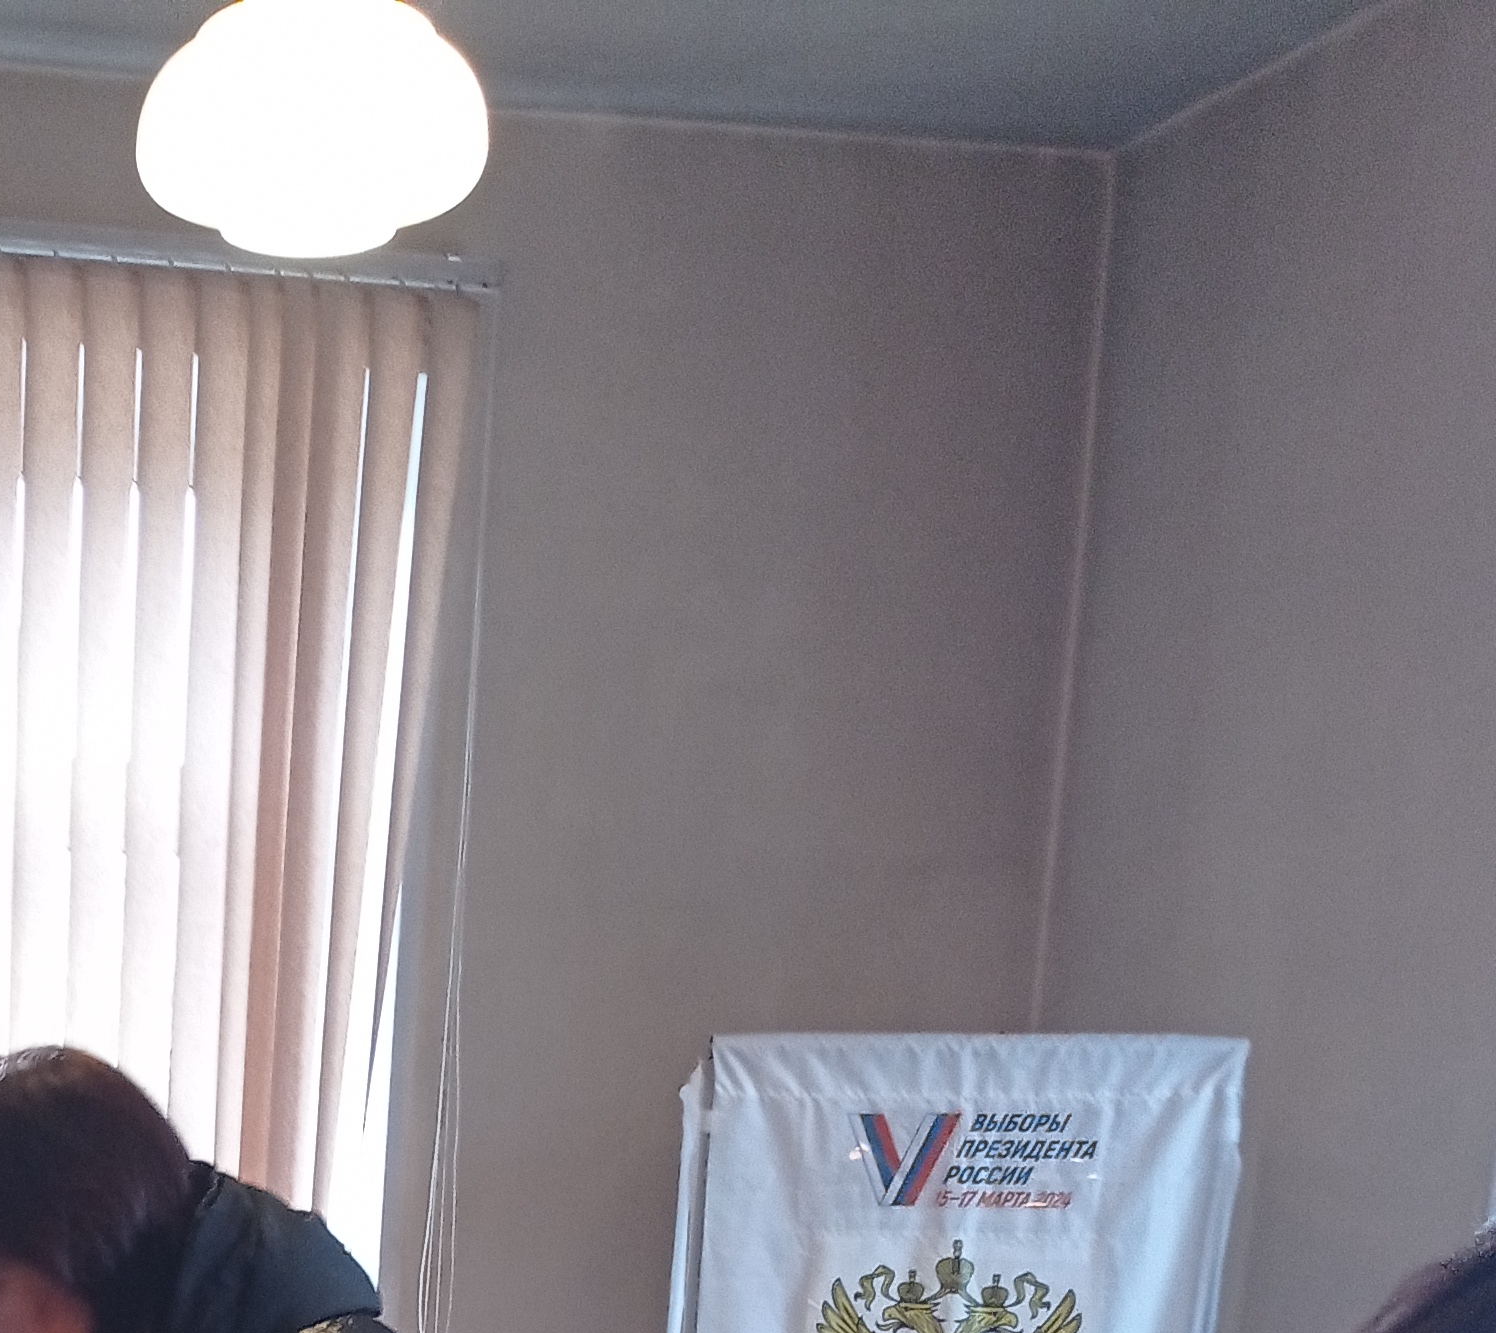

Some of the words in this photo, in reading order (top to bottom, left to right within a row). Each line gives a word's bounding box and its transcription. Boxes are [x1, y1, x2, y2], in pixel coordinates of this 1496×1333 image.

[969, 1112, 1072, 1133] ВЫБОРЫ
[956, 1139, 1099, 1162] ПРЕЗИДЕНТА
[943, 1165, 1035, 1185] РОССИИ
[975, 1190, 1032, 1208] МАРТА
